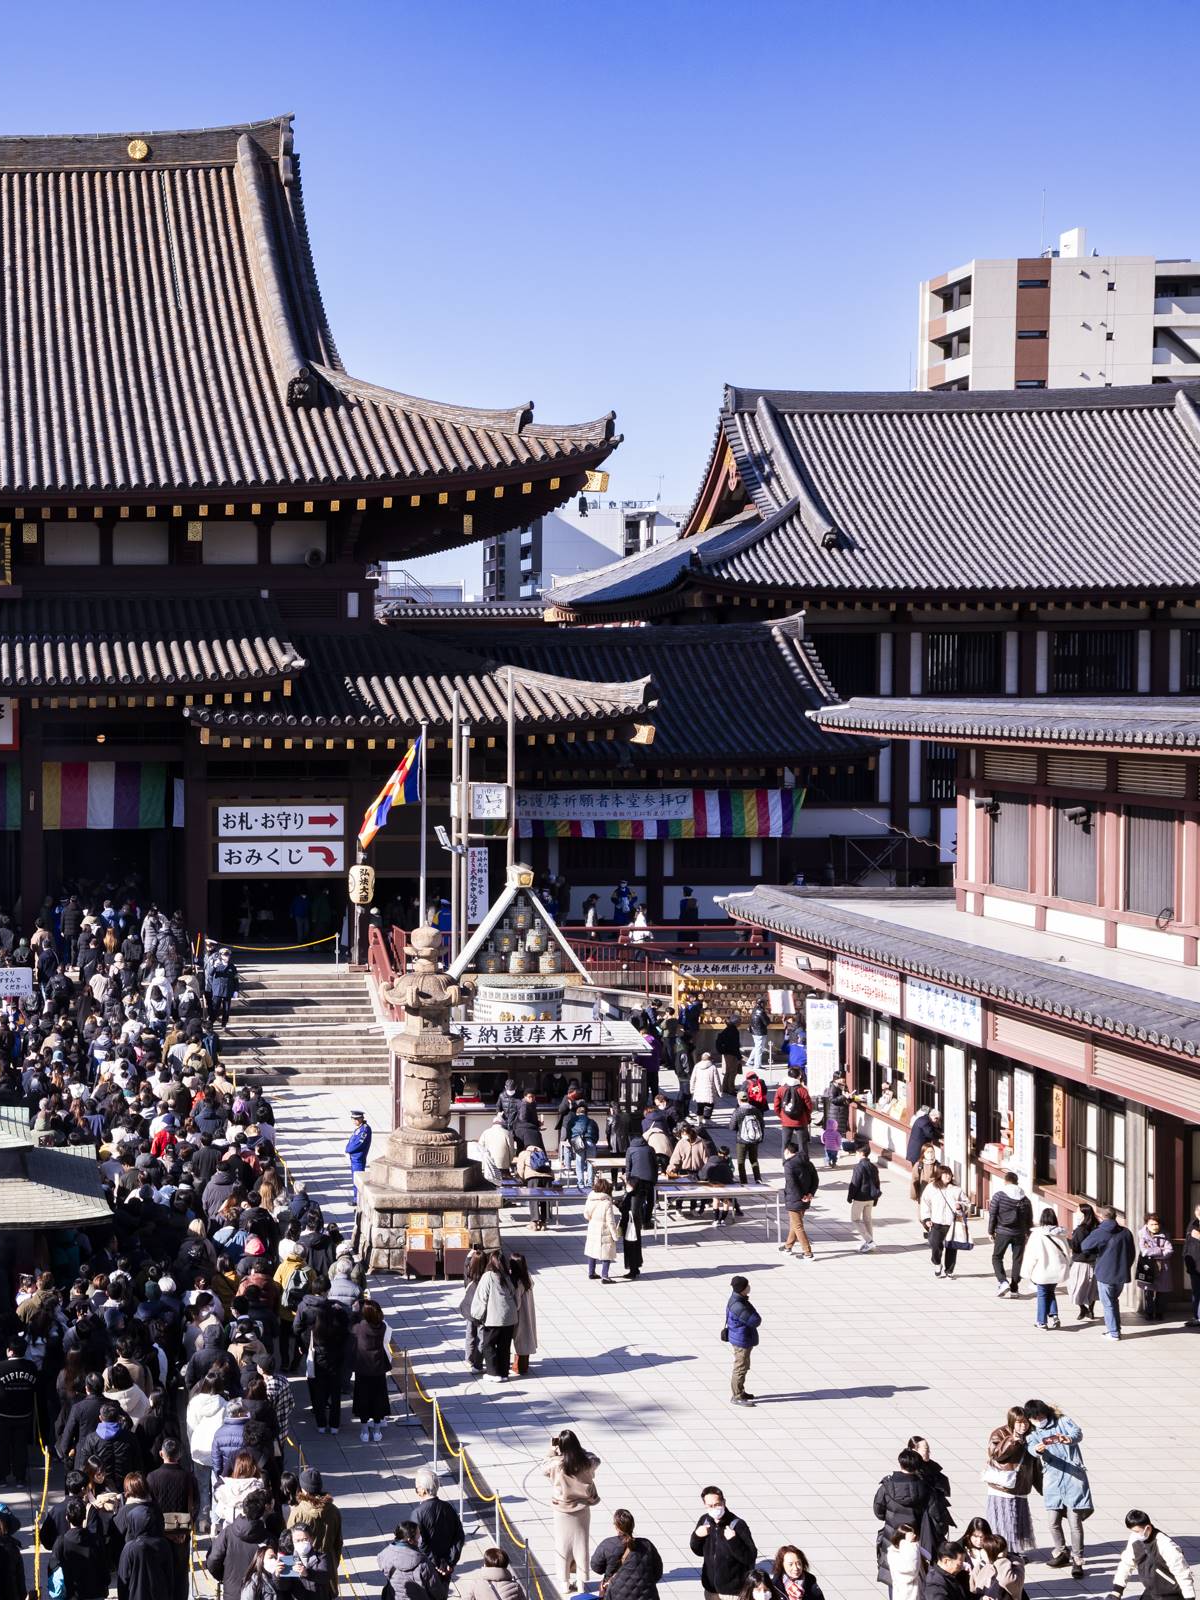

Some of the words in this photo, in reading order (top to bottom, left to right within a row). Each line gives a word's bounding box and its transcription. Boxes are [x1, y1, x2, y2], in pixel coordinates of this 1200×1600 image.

[515, 793, 689, 808] お護摩祈願者本堂参拝口
[222, 812, 304, 831] お札・お守り
[224, 848, 303, 866] おみくじ
[359, 868, 370, 902] 弘法大師
[459, 1024, 593, 1044] 奉納護摩木所
